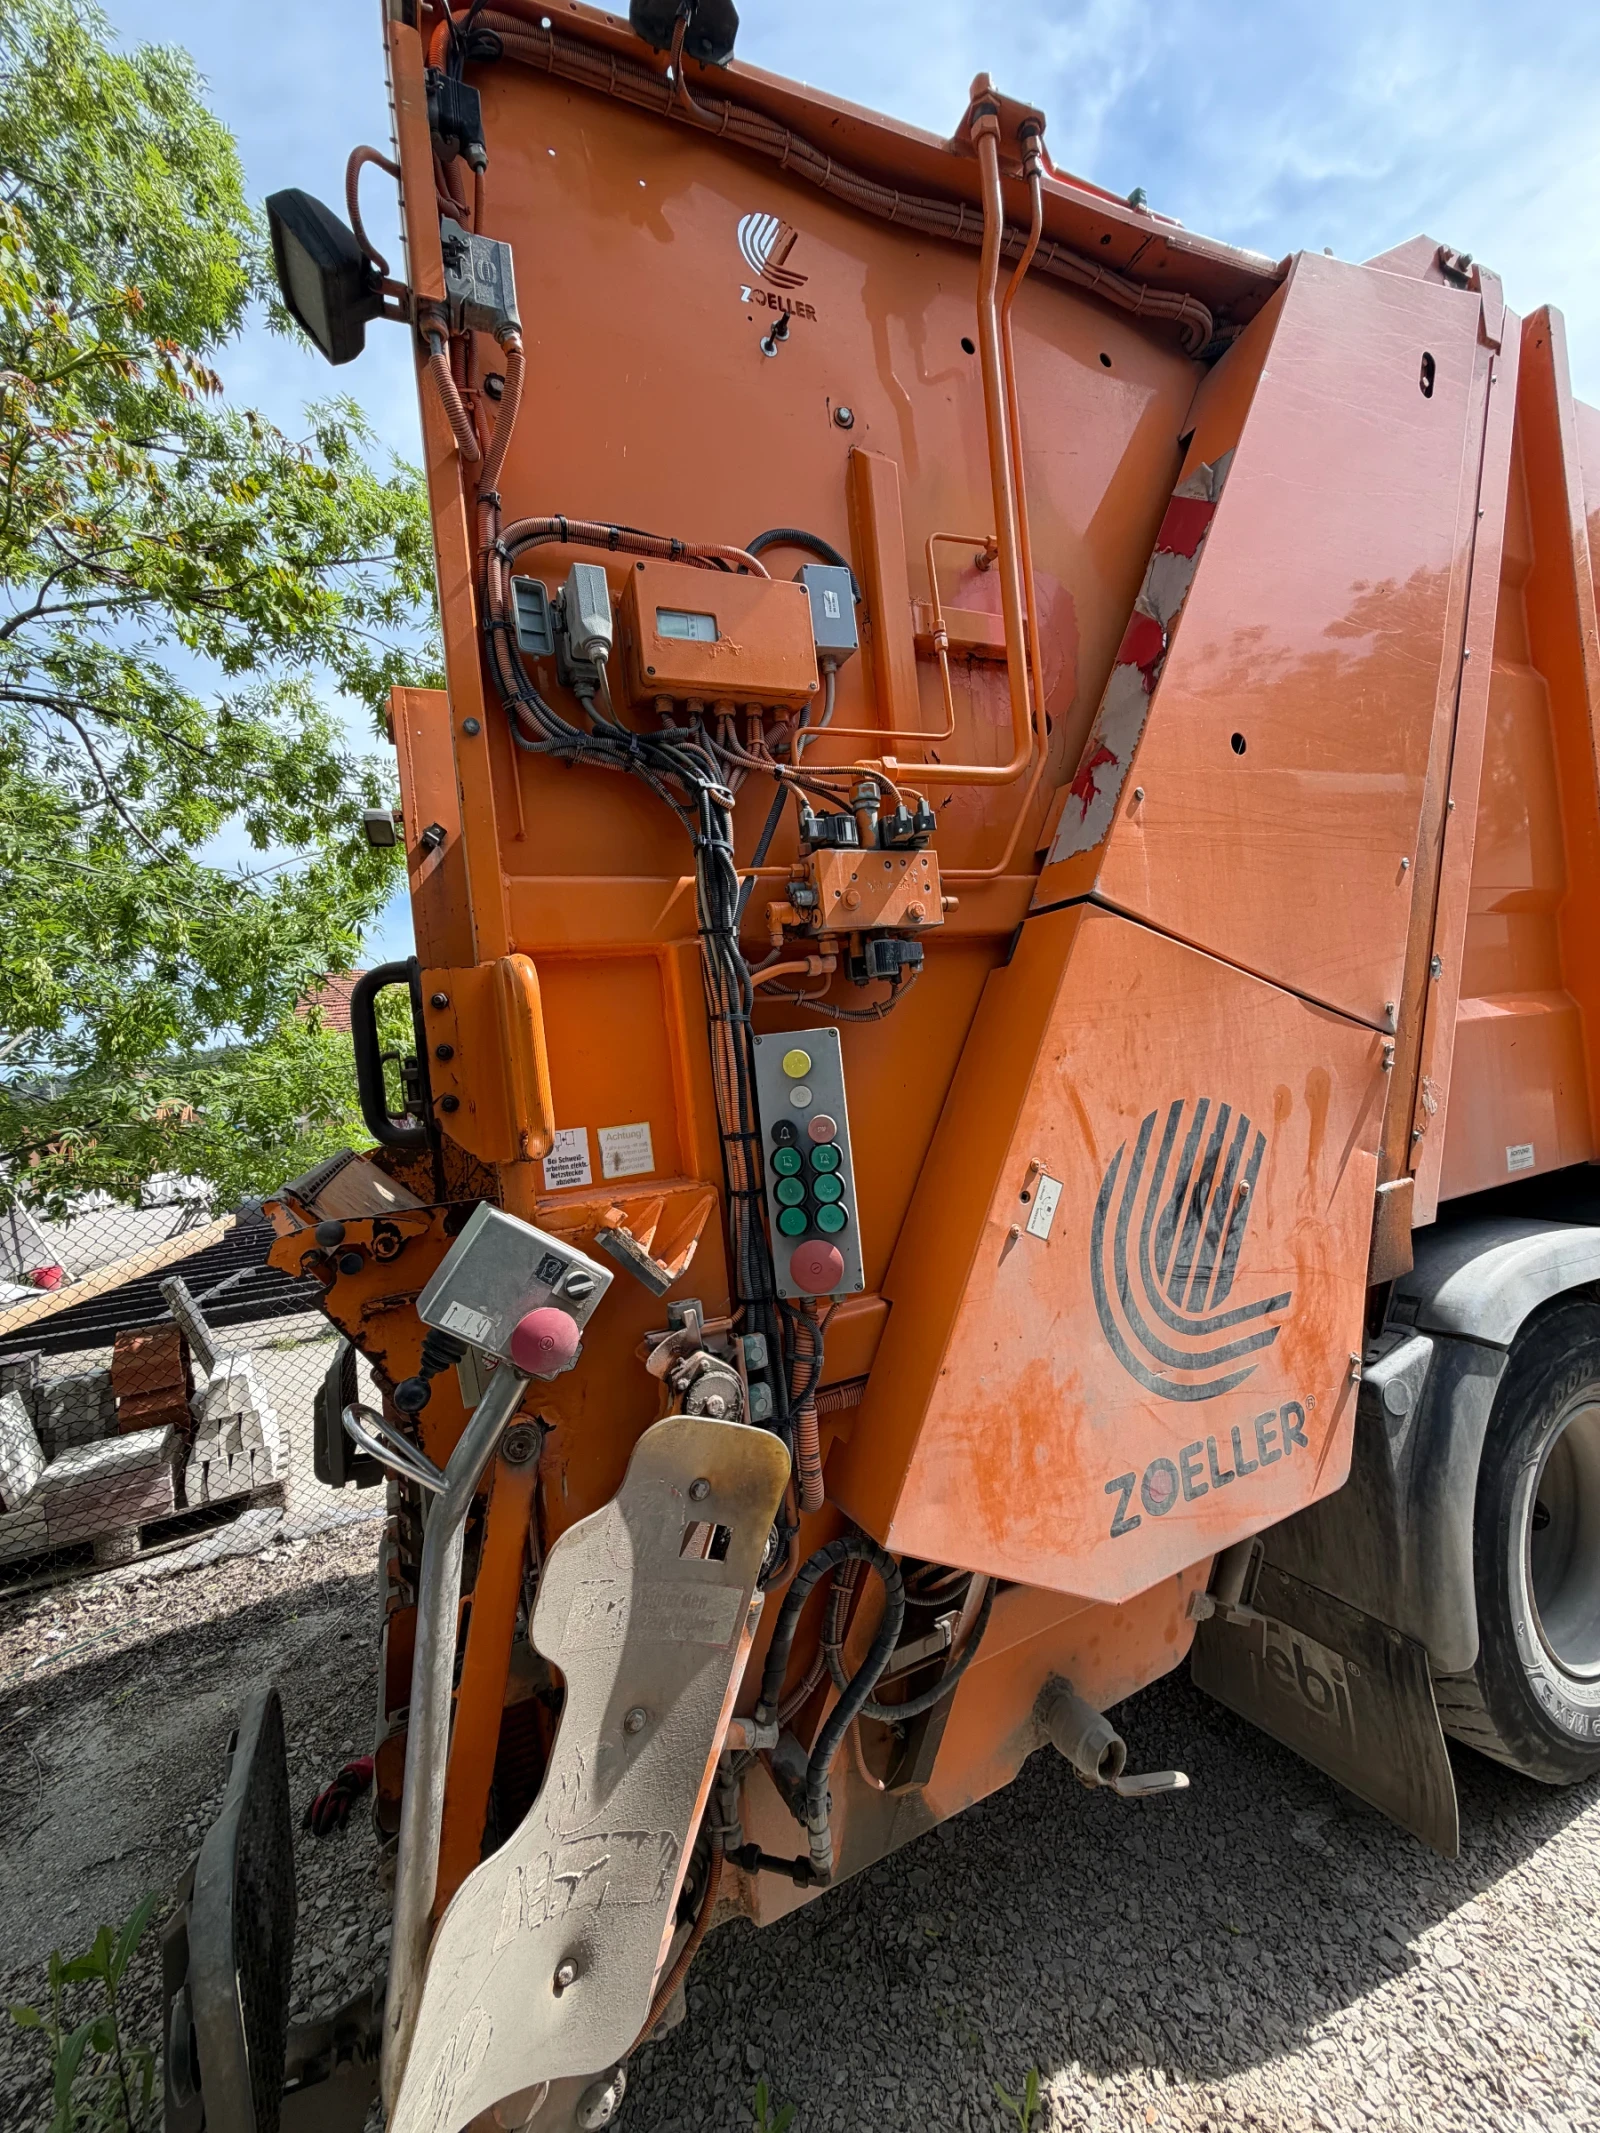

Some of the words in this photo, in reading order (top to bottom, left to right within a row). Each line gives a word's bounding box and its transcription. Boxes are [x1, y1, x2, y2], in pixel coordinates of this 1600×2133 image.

[740, 284, 817, 322] ZOELLER
[606, 1128, 645, 1141] Achtung!
[550, 1169, 584, 1180] Netzstecker
[556, 1177, 582, 1187] abziehen
